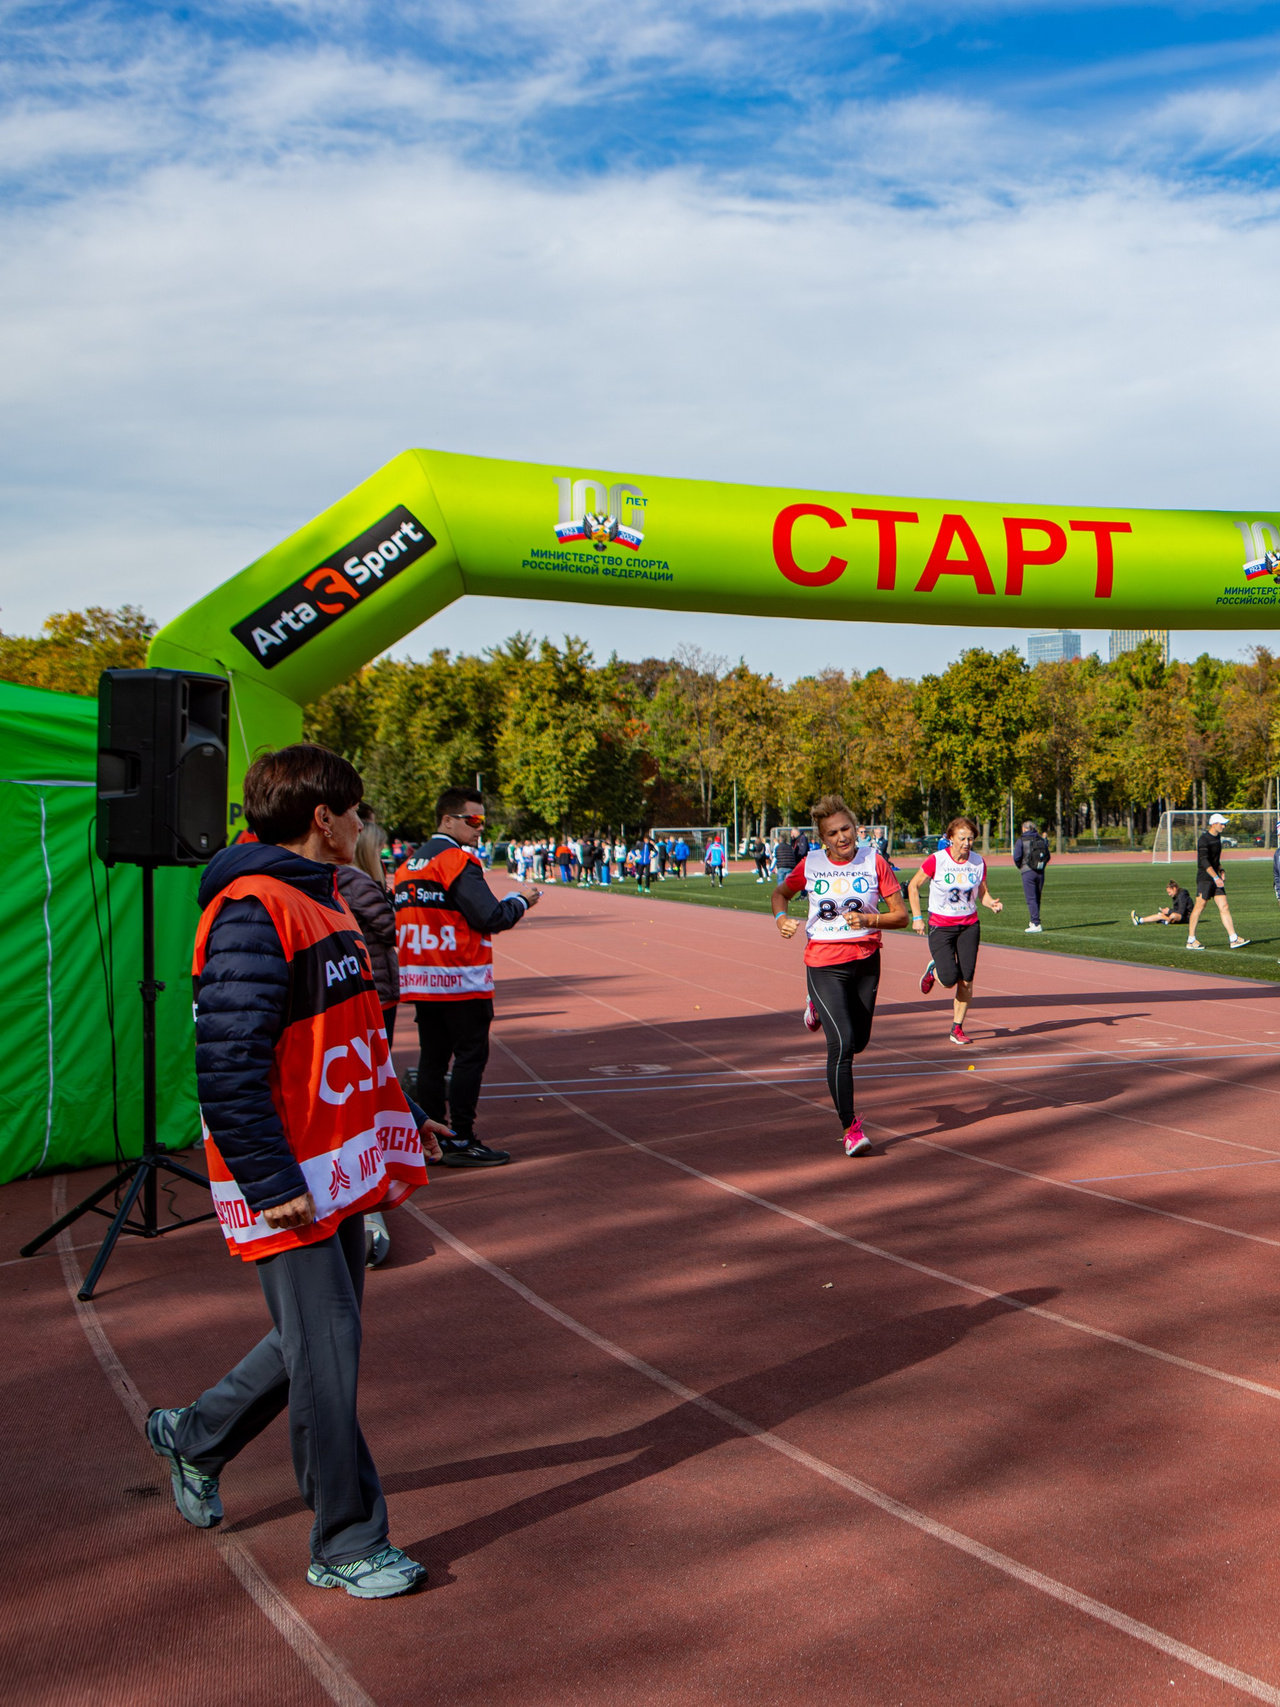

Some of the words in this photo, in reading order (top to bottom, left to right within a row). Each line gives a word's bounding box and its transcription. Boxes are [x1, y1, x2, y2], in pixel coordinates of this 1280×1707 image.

[625, 496, 649, 507] ЛЕТ
[561, 525, 579, 537] 1923
[619, 530, 637, 544] 2023
[772, 503, 1133, 599] СТАРТ
[530, 548, 623, 567] МИНИСТЕРСТВО
[625, 557, 670, 571] СПОРТА
[521, 559, 600, 576] РОССИЙСКОЙ
[601, 567, 674, 582] ФЕДЕРАЦИИ
[1248, 565, 1262, 574] 1923
[251, 601, 319, 657] Arta
[343, 521, 424, 586] Sport
[1215, 594, 1277, 605] РОССИЙСКОЙ
[430, 974, 463, 988] СПОРТ
